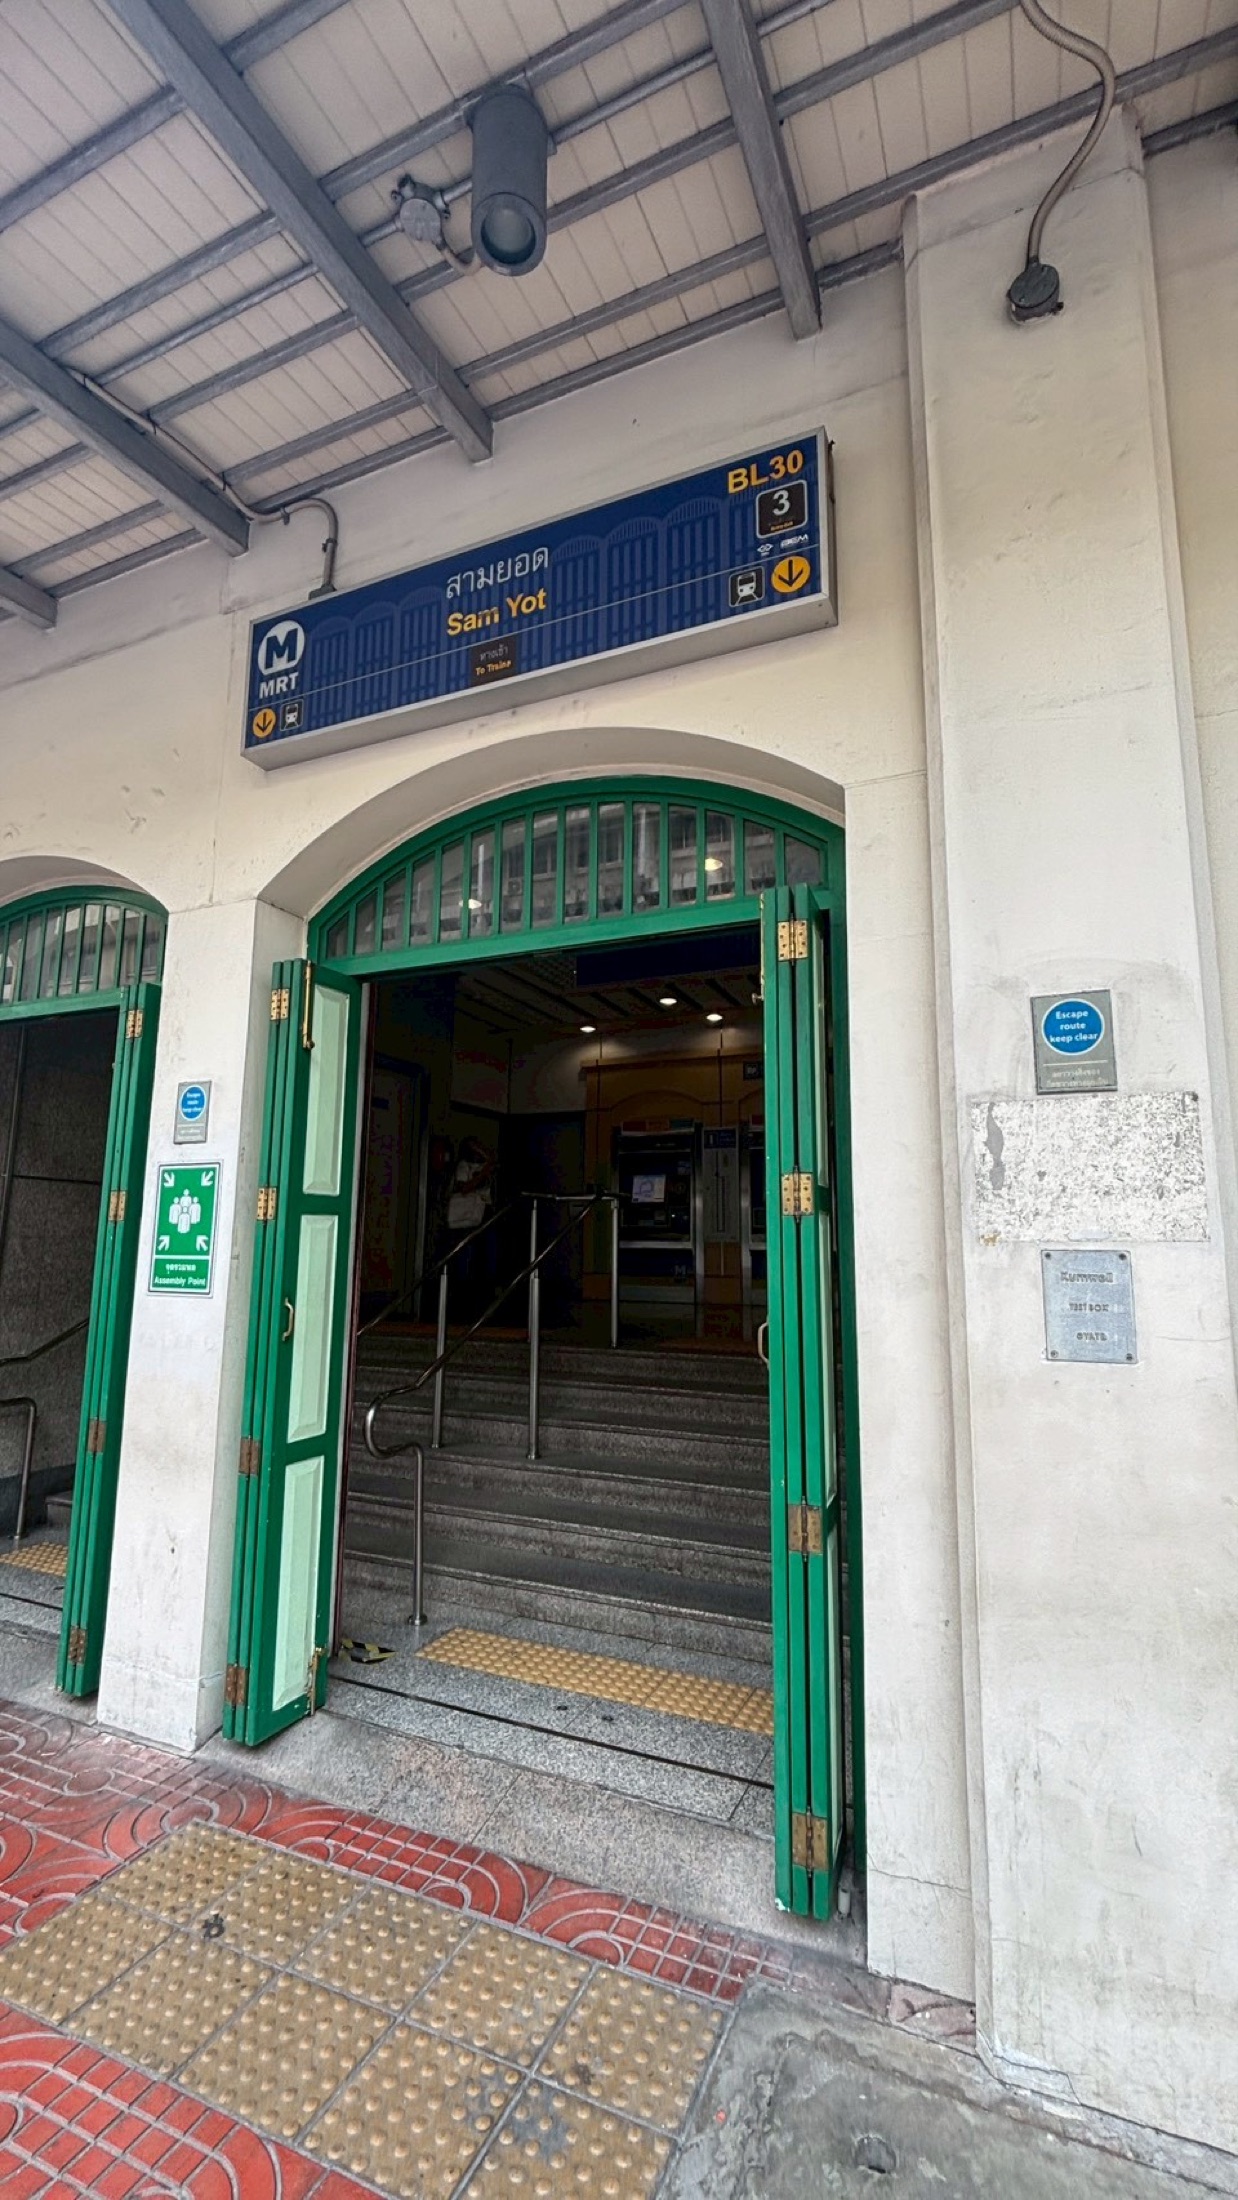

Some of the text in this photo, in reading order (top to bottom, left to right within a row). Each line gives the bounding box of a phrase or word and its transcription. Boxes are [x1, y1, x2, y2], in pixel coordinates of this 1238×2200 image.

[727, 449, 804, 494] BL30
[772, 488, 791, 517] 3
[446, 547, 549, 599] สามยอด
[446, 587, 548, 636] Sam Yot
[259, 672, 299, 699] MRT
[1055, 1010, 1089, 1020] Escape
[1060, 1022, 1087, 1030] route
[1049, 1032, 1099, 1044] keep clear
[154, 1275, 206, 1287] Assembly Point
